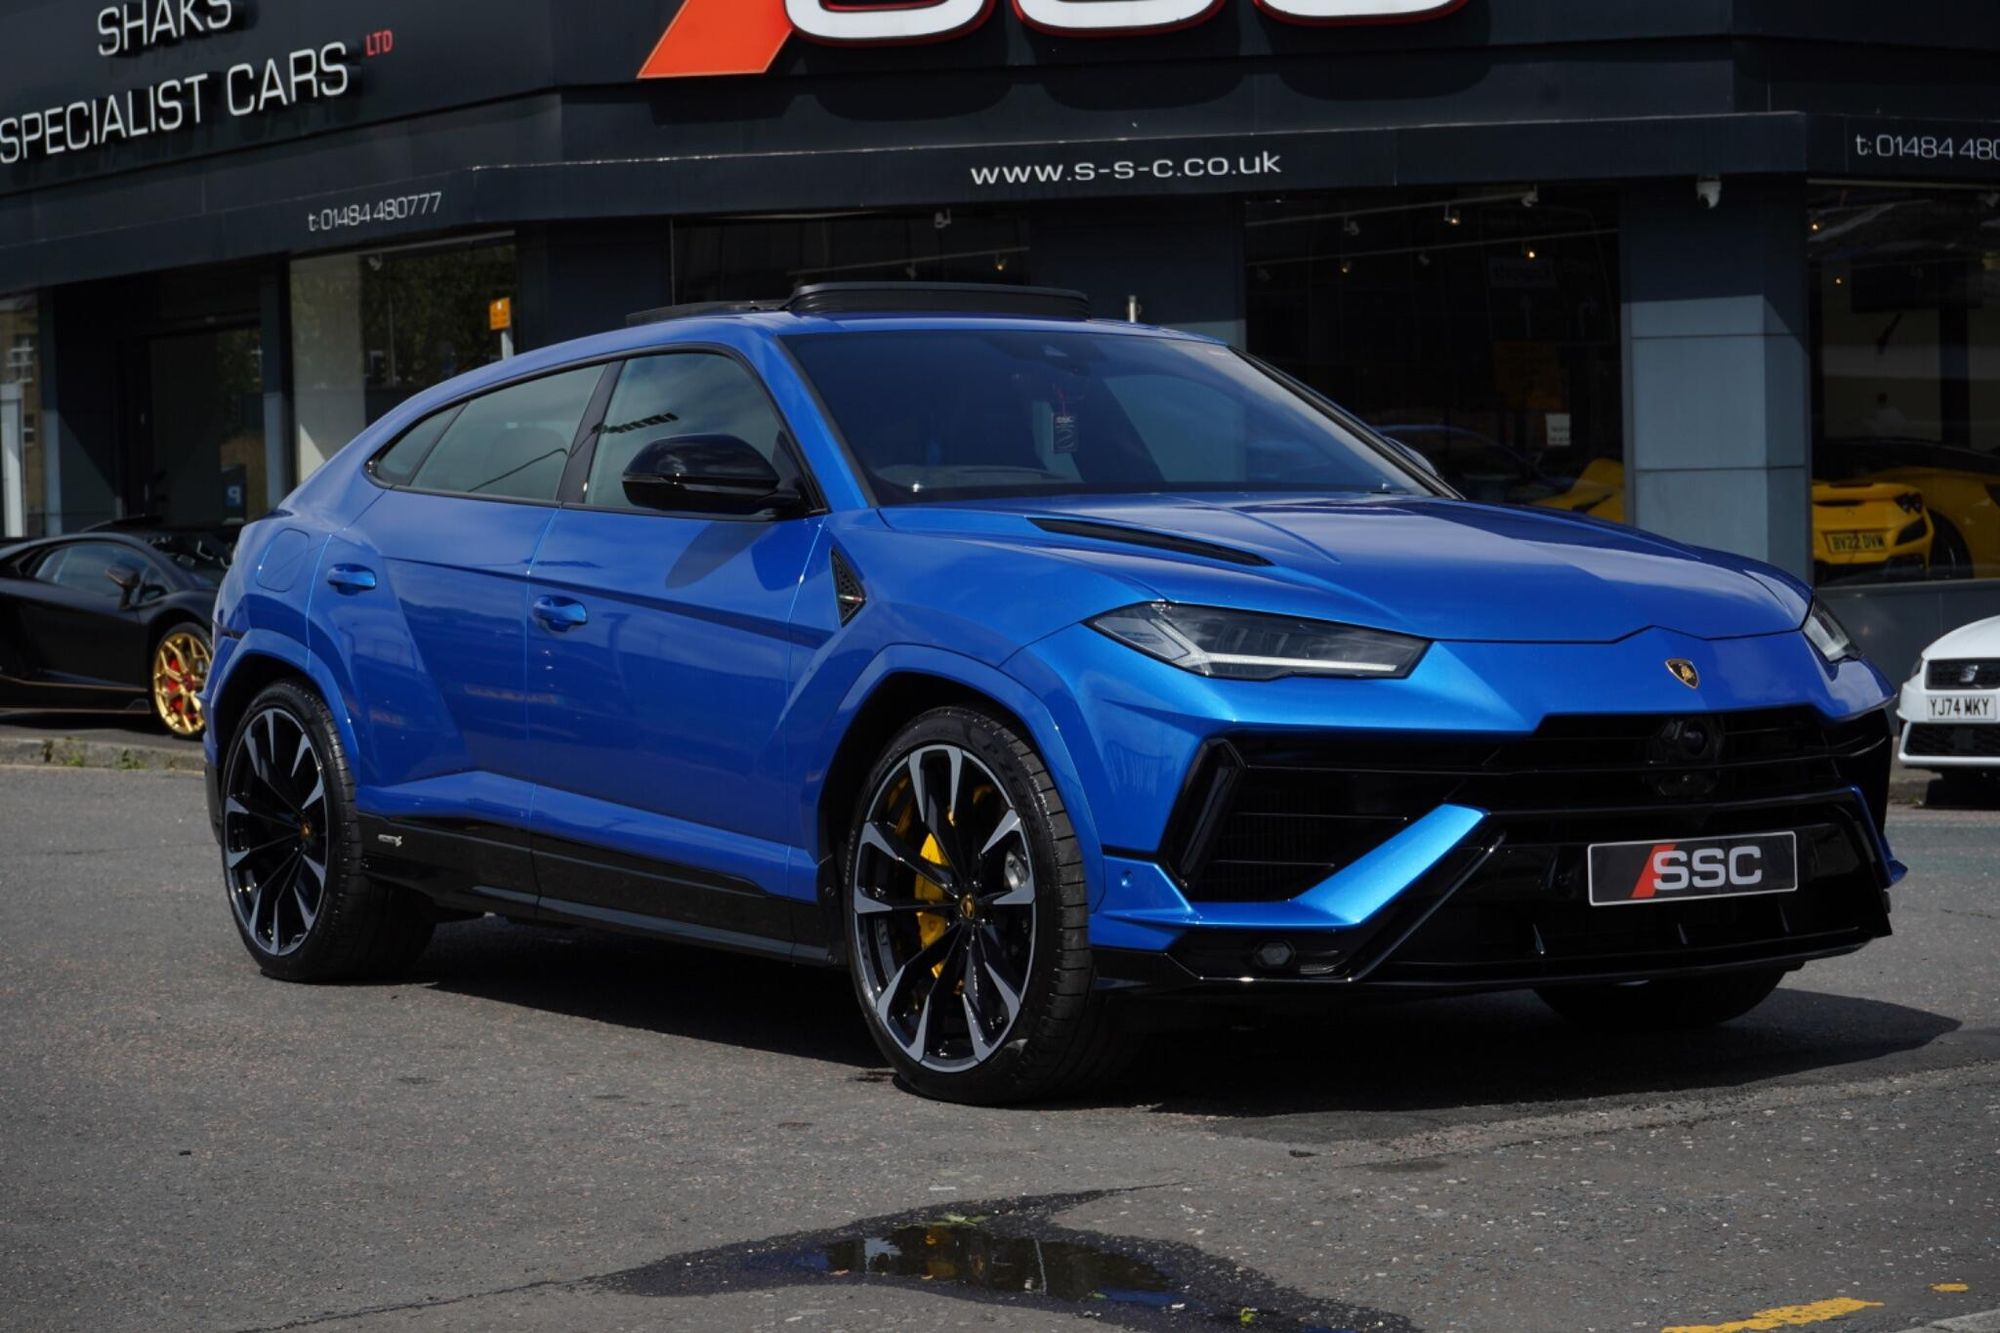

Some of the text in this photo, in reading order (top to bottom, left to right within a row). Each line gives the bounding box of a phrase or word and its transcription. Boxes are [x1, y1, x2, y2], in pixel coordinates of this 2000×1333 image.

[97, 0, 232, 56] SHAKS
[0, 30, 393, 164] SPECIALIST CARS LTD
[970, 151, 1282, 185] www.s-s-c.co.uk
[373, 191, 442, 221] 480777
[1930, 698, 1989, 716] YJ74 MKY
[1652, 845, 1763, 891] SSC
